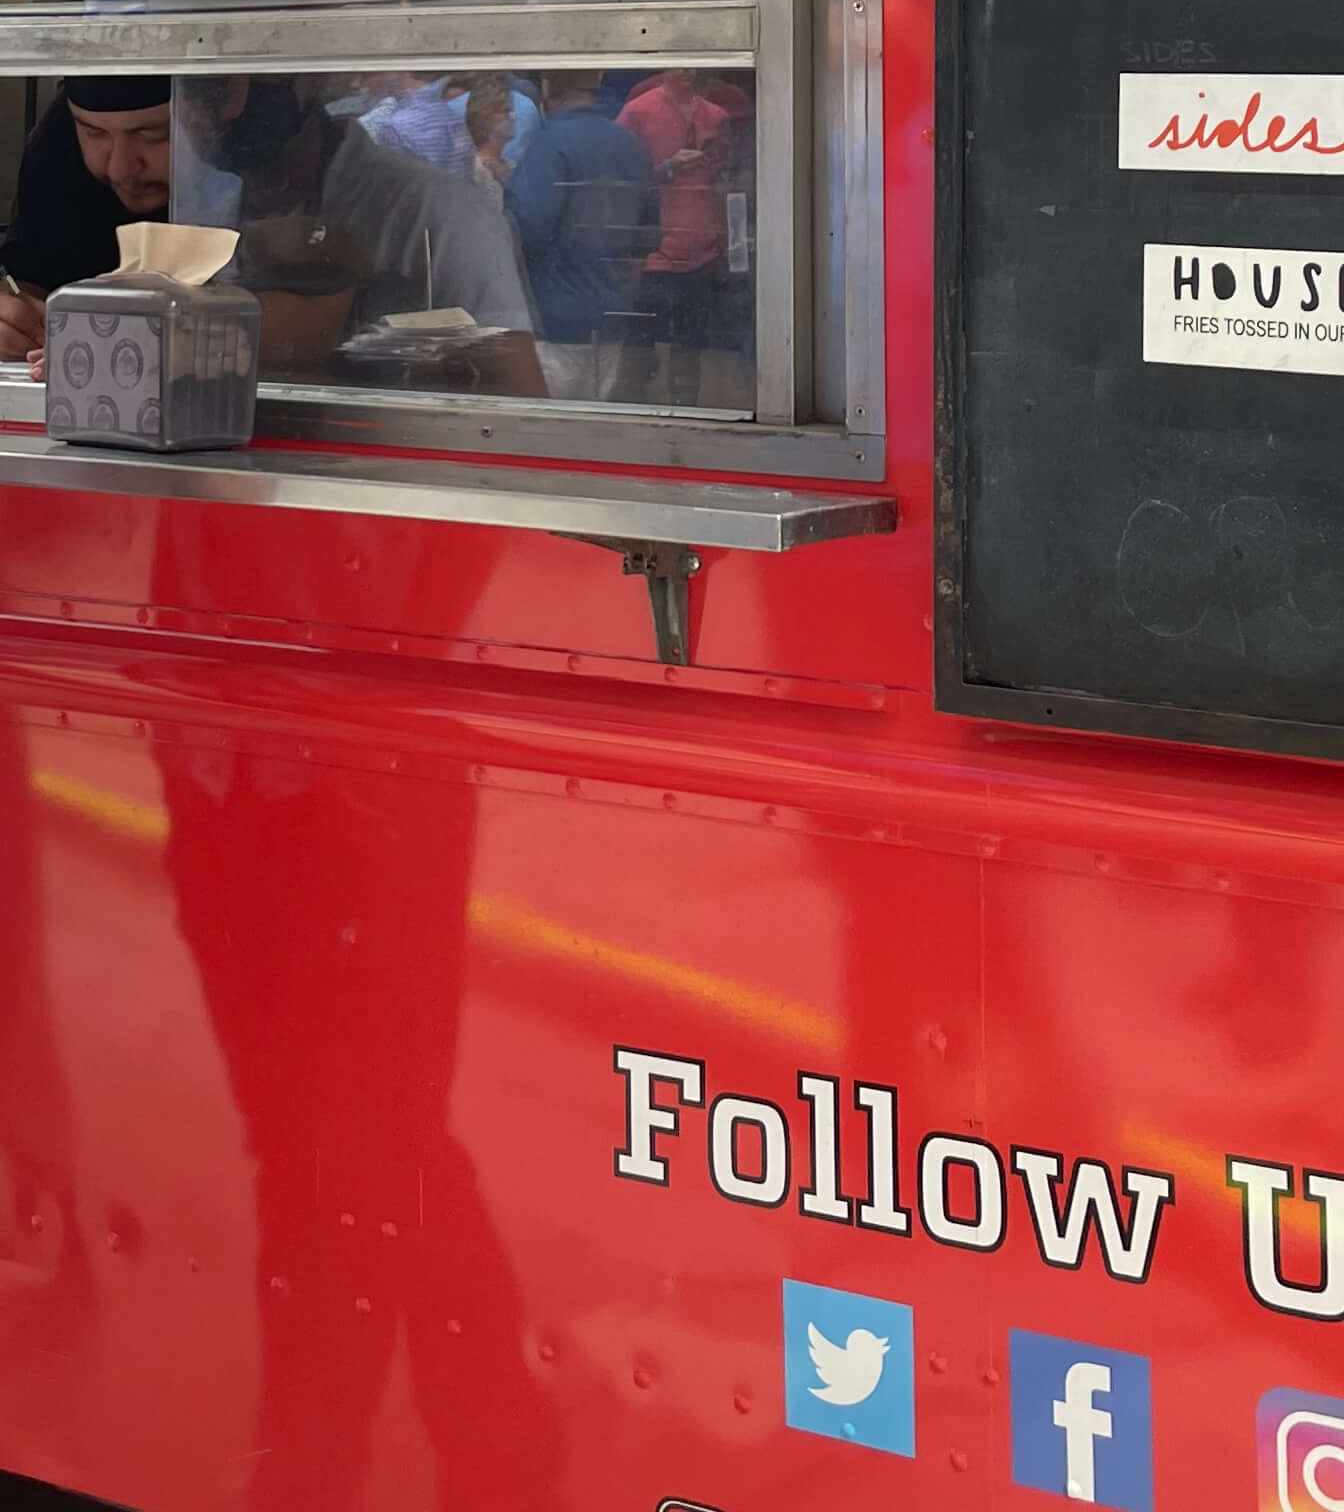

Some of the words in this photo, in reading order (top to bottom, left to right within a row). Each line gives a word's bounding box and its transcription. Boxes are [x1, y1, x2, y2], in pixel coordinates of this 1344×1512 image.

[1174, 313, 1219, 334] FRIES
[1225, 316, 1289, 339] TOSSED
[1294, 321, 1310, 340] IN
[614, 1044, 1175, 1284] Follow
